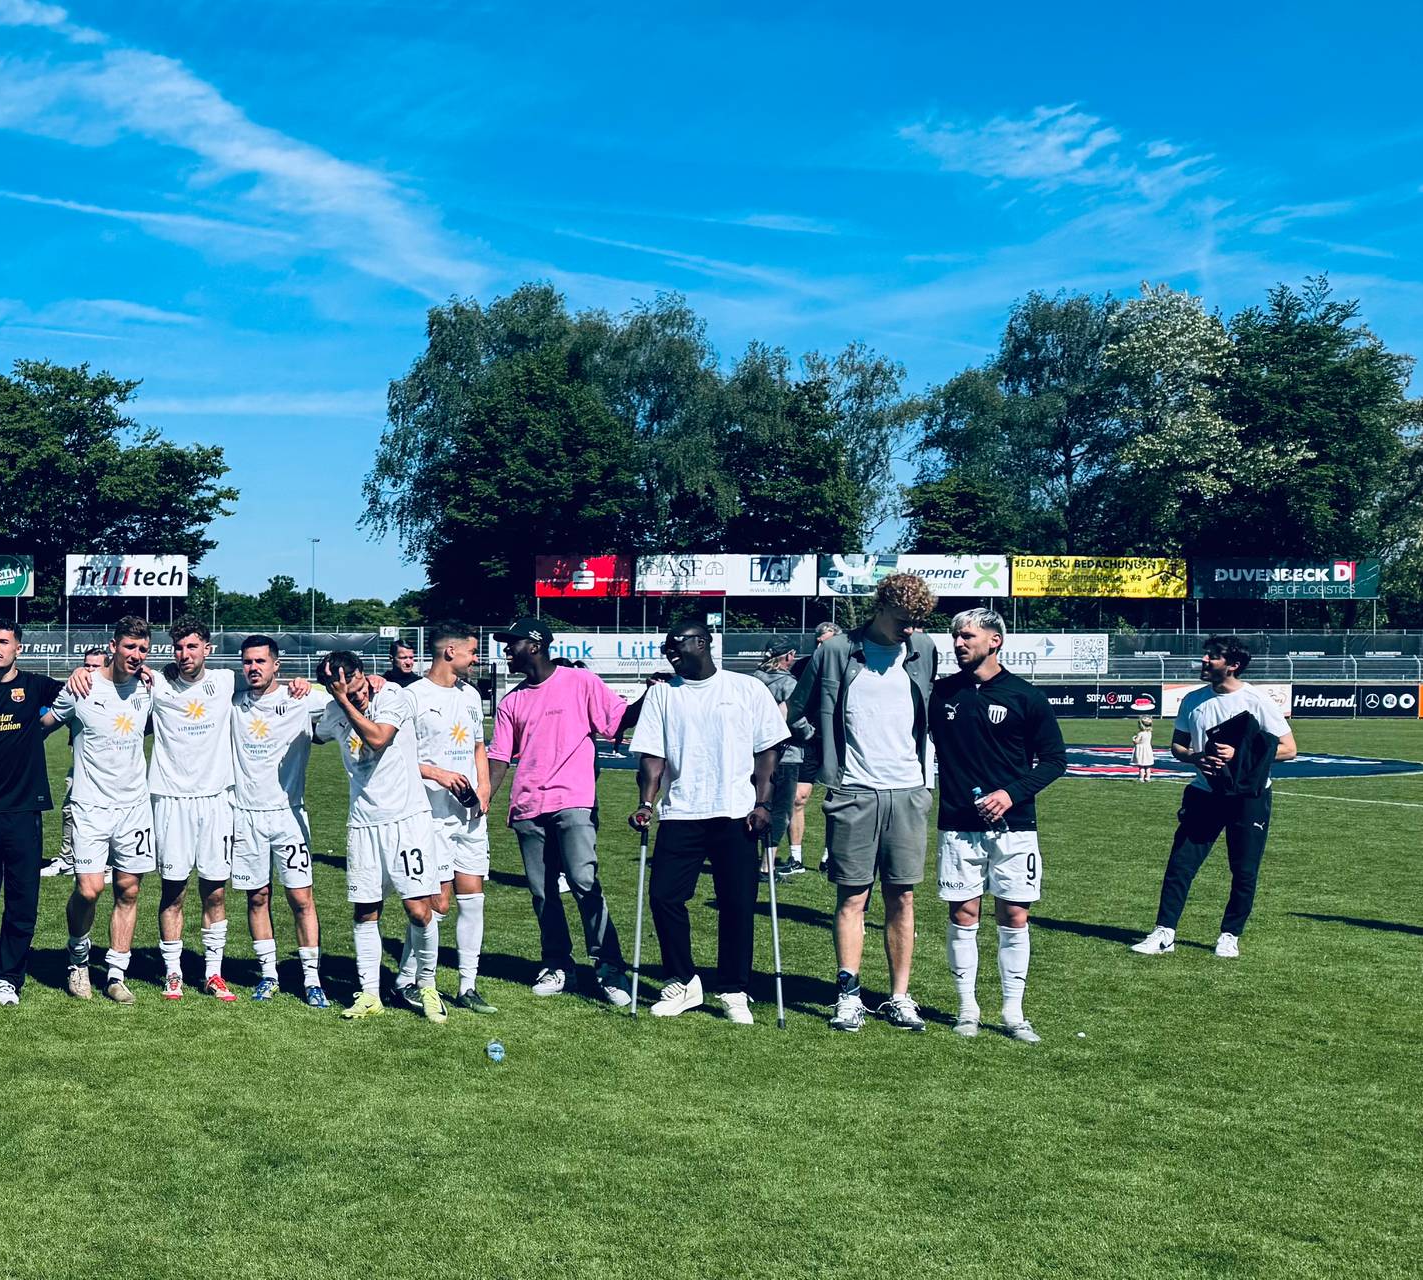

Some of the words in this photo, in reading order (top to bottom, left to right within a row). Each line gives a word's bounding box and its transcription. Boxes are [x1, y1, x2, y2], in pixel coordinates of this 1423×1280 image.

[661, 559, 702, 577] ASF
[1215, 568, 1330, 582] DUVENBECK
[1286, 585, 1300, 594] OF
[1302, 585, 1356, 594] LOGISTICS
[33, 643, 62, 653] RENT
[150, 644, 175, 654] EVE
[1293, 694, 1357, 708] Herbrand.
[286, 842, 310, 869] 25
[400, 848, 424, 877] 13
[1027, 852, 1036, 881] 9
